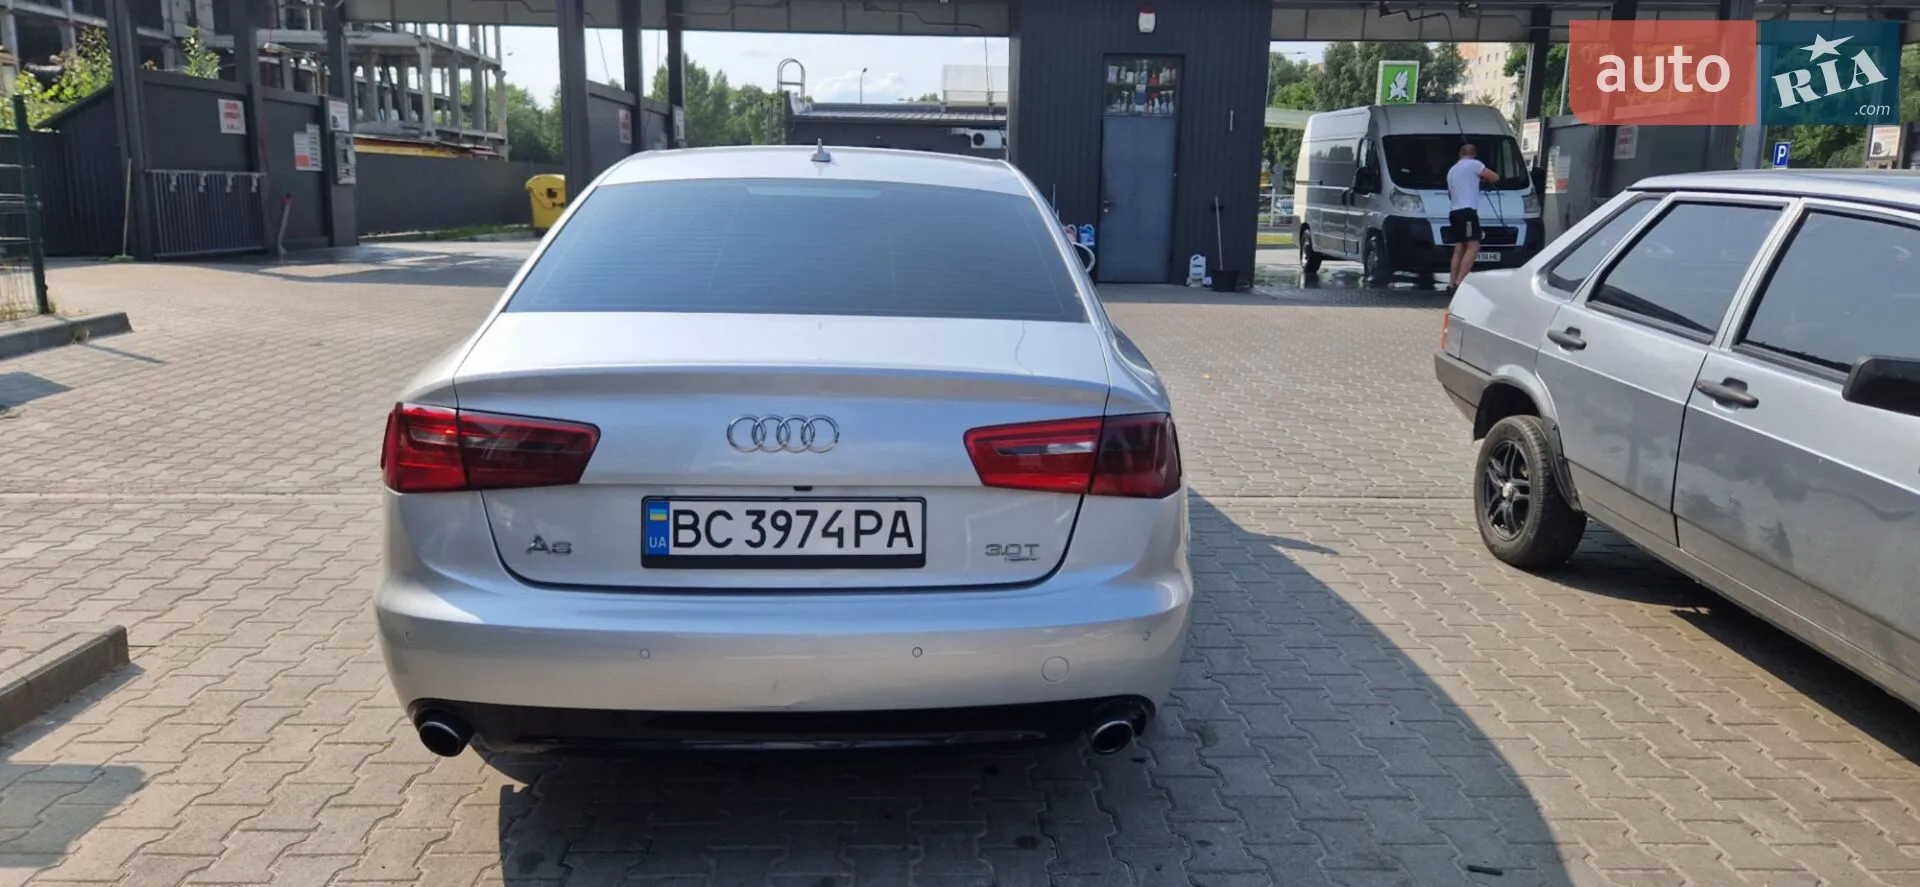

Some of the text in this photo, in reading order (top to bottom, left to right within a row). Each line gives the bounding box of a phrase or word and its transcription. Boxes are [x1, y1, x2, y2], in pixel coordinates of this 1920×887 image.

[1776, 145, 1787, 164] P
[673, 509, 914, 549] BC 3974 PA
[526, 535, 573, 555] A6
[649, 536, 667, 549] UA
